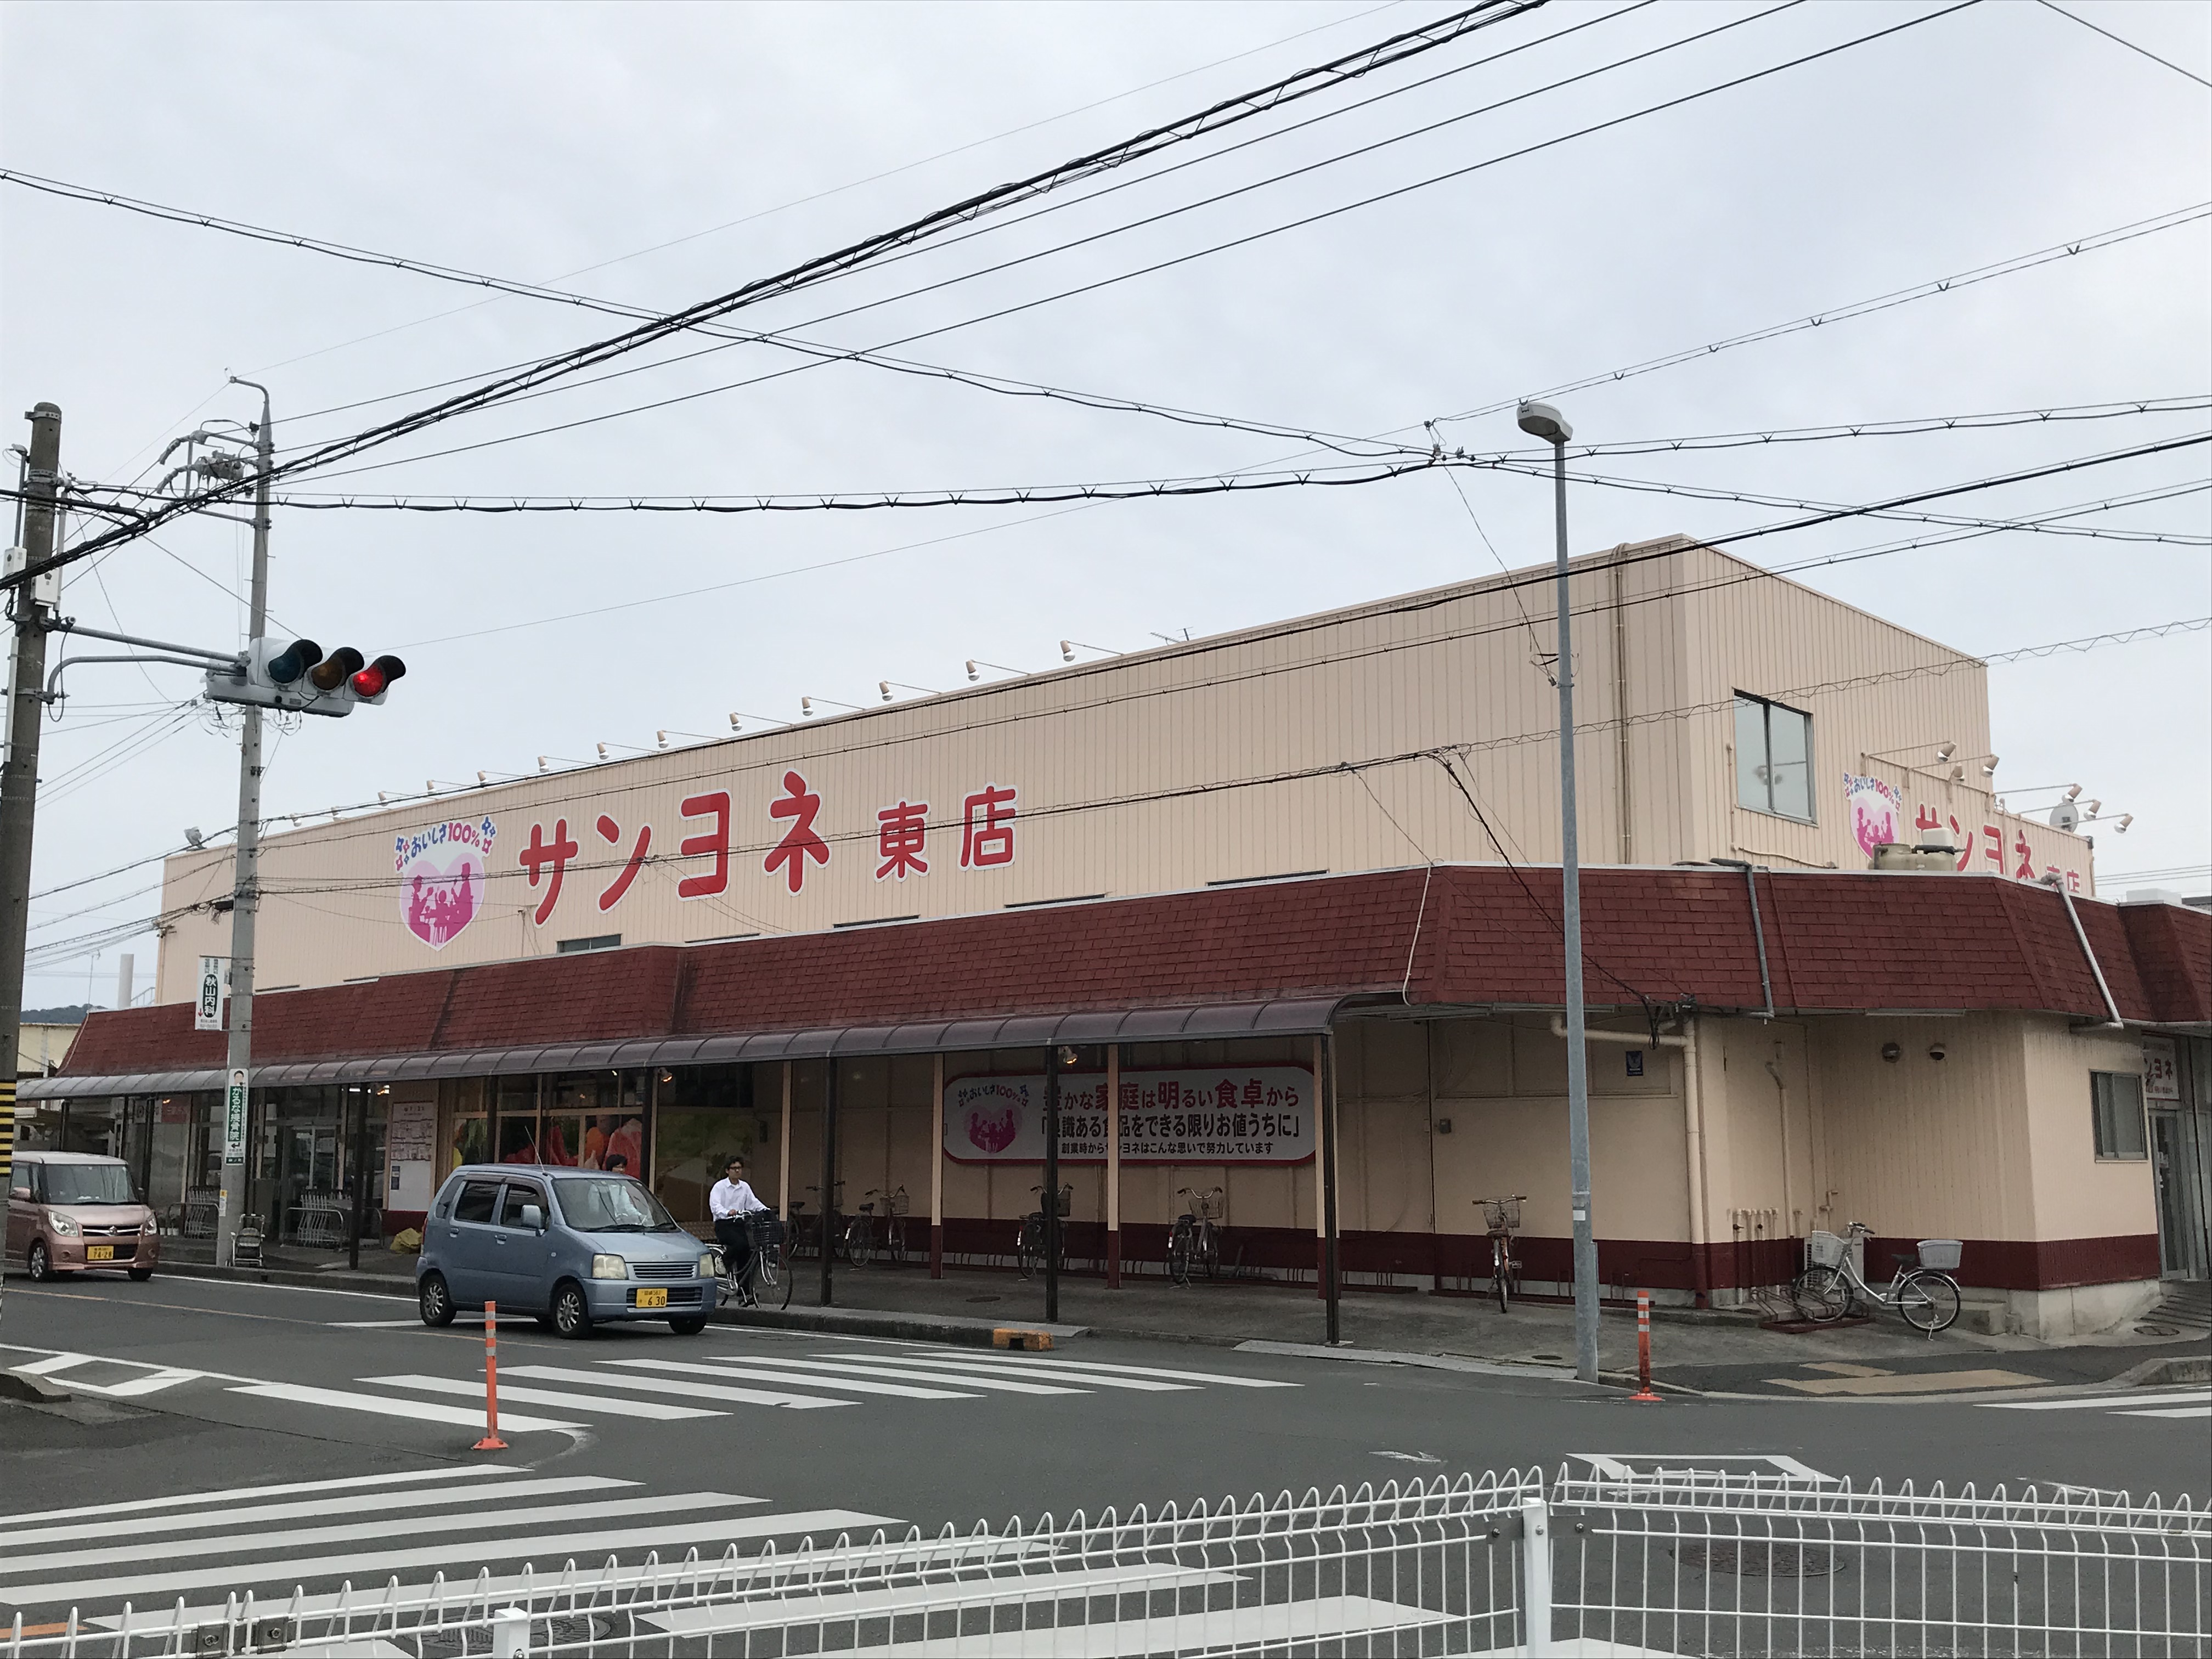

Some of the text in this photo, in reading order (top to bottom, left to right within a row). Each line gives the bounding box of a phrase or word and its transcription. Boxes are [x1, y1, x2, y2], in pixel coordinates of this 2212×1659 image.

[1854, 776, 1895, 804] おいしさ100%
[410, 821, 481, 858] おいしさ100%
[204, 977, 217, 1015] 秋山内科
[969, 1084, 1020, 1102] おいしさ100%
[1041, 1113, 1300, 1139] 「識ある品をできる限りお値うちに」
[1061, 1142, 1273, 1155] 創業時からヨネはこんな思いで努力しています
